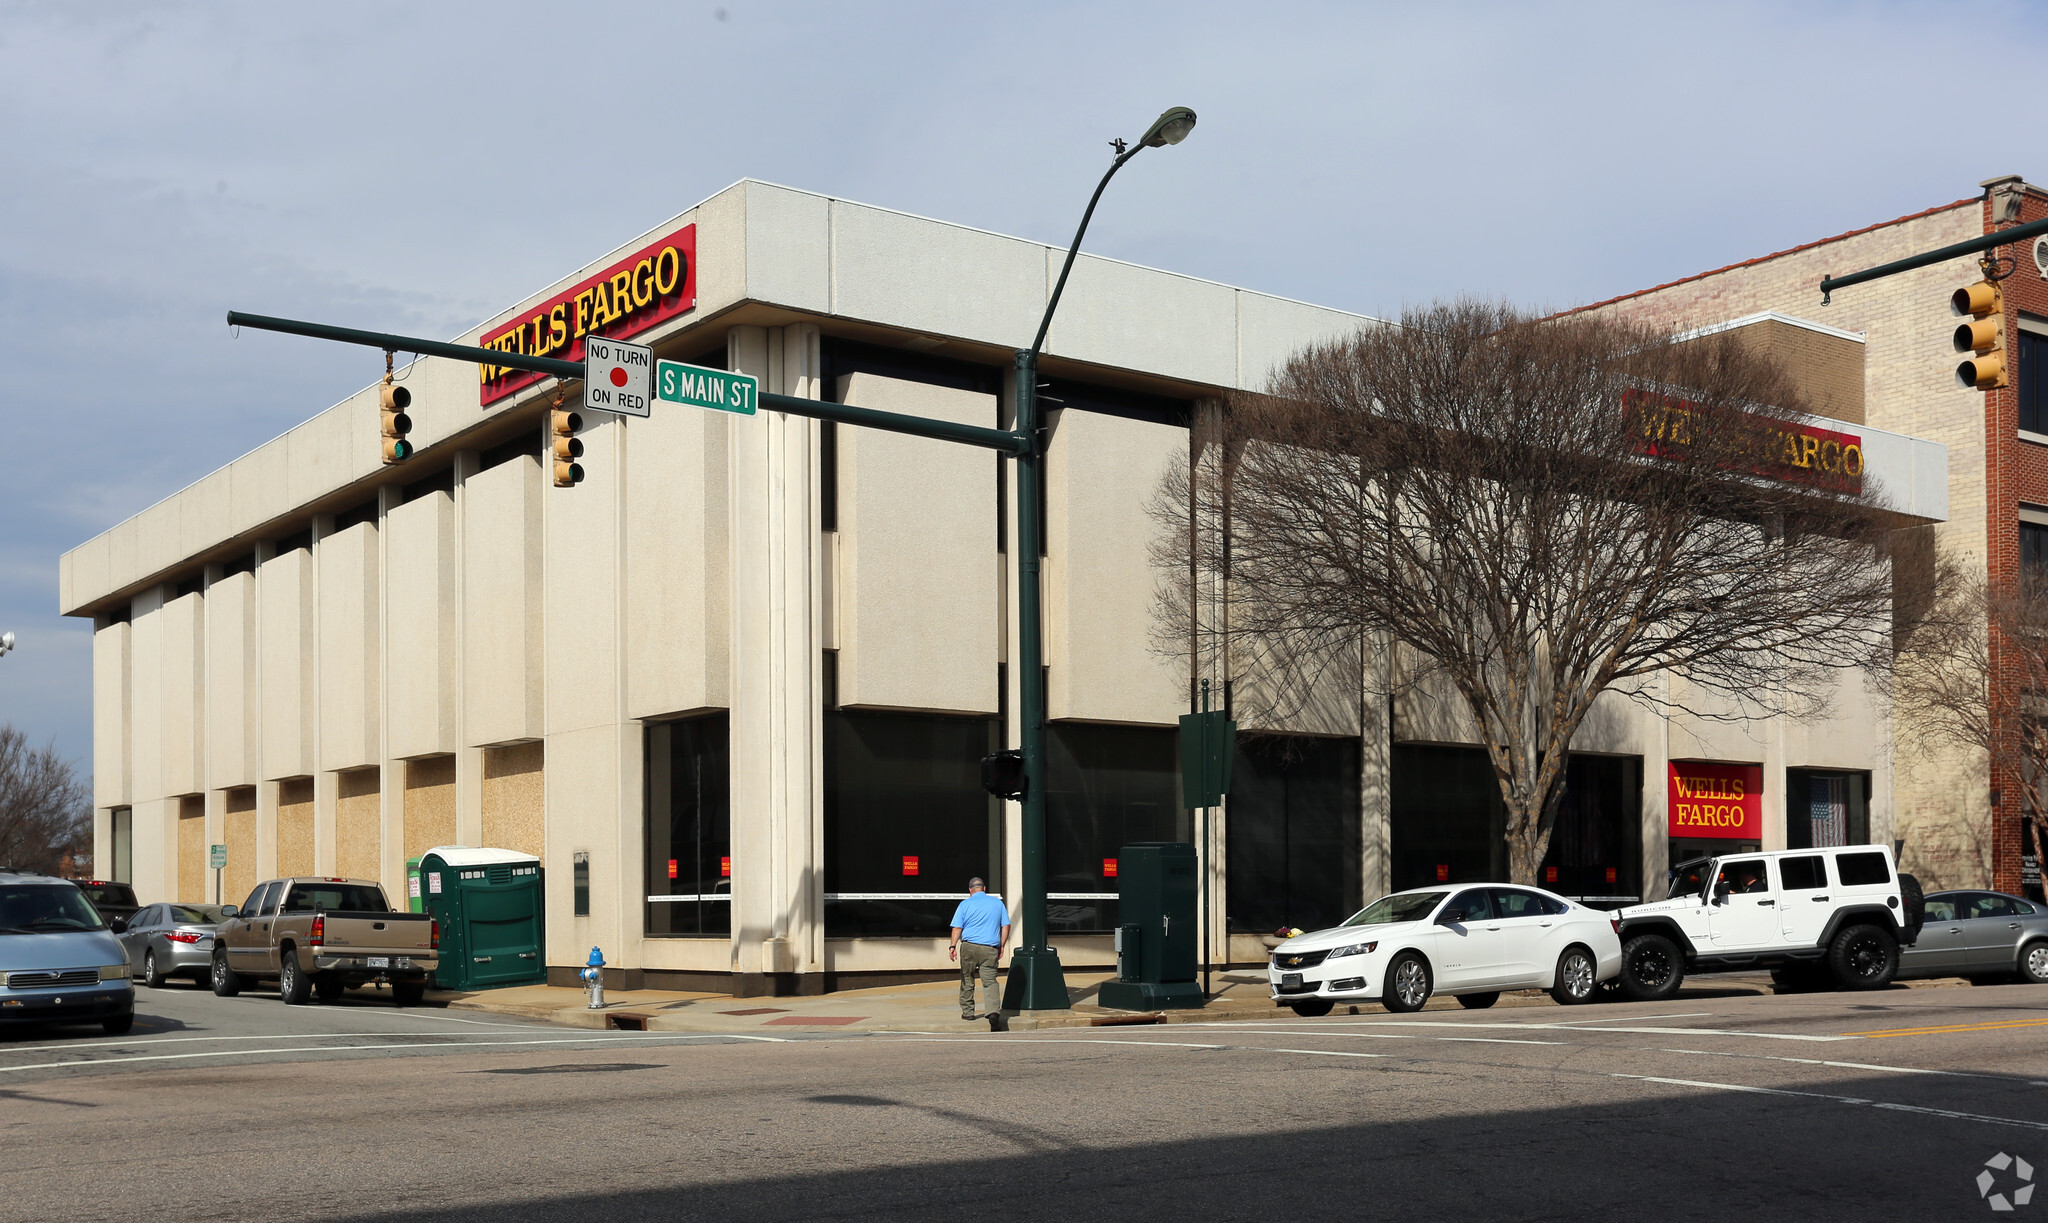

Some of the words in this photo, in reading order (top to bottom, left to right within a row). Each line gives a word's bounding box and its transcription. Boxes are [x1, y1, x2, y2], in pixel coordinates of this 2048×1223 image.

[479, 302, 567, 384] WELLS
[574, 246, 679, 338] FARGO
[591, 344, 609, 360] NO
[615, 348, 648, 367] TURN
[592, 389, 610, 404] ON
[618, 393, 644, 409] RED
[664, 369, 675, 395] S
[681, 372, 725, 404] MAIN
[731, 381, 752, 408] ST
[1674, 776, 1744, 801] WELLS
[1676, 803, 1745, 827] FARGO
